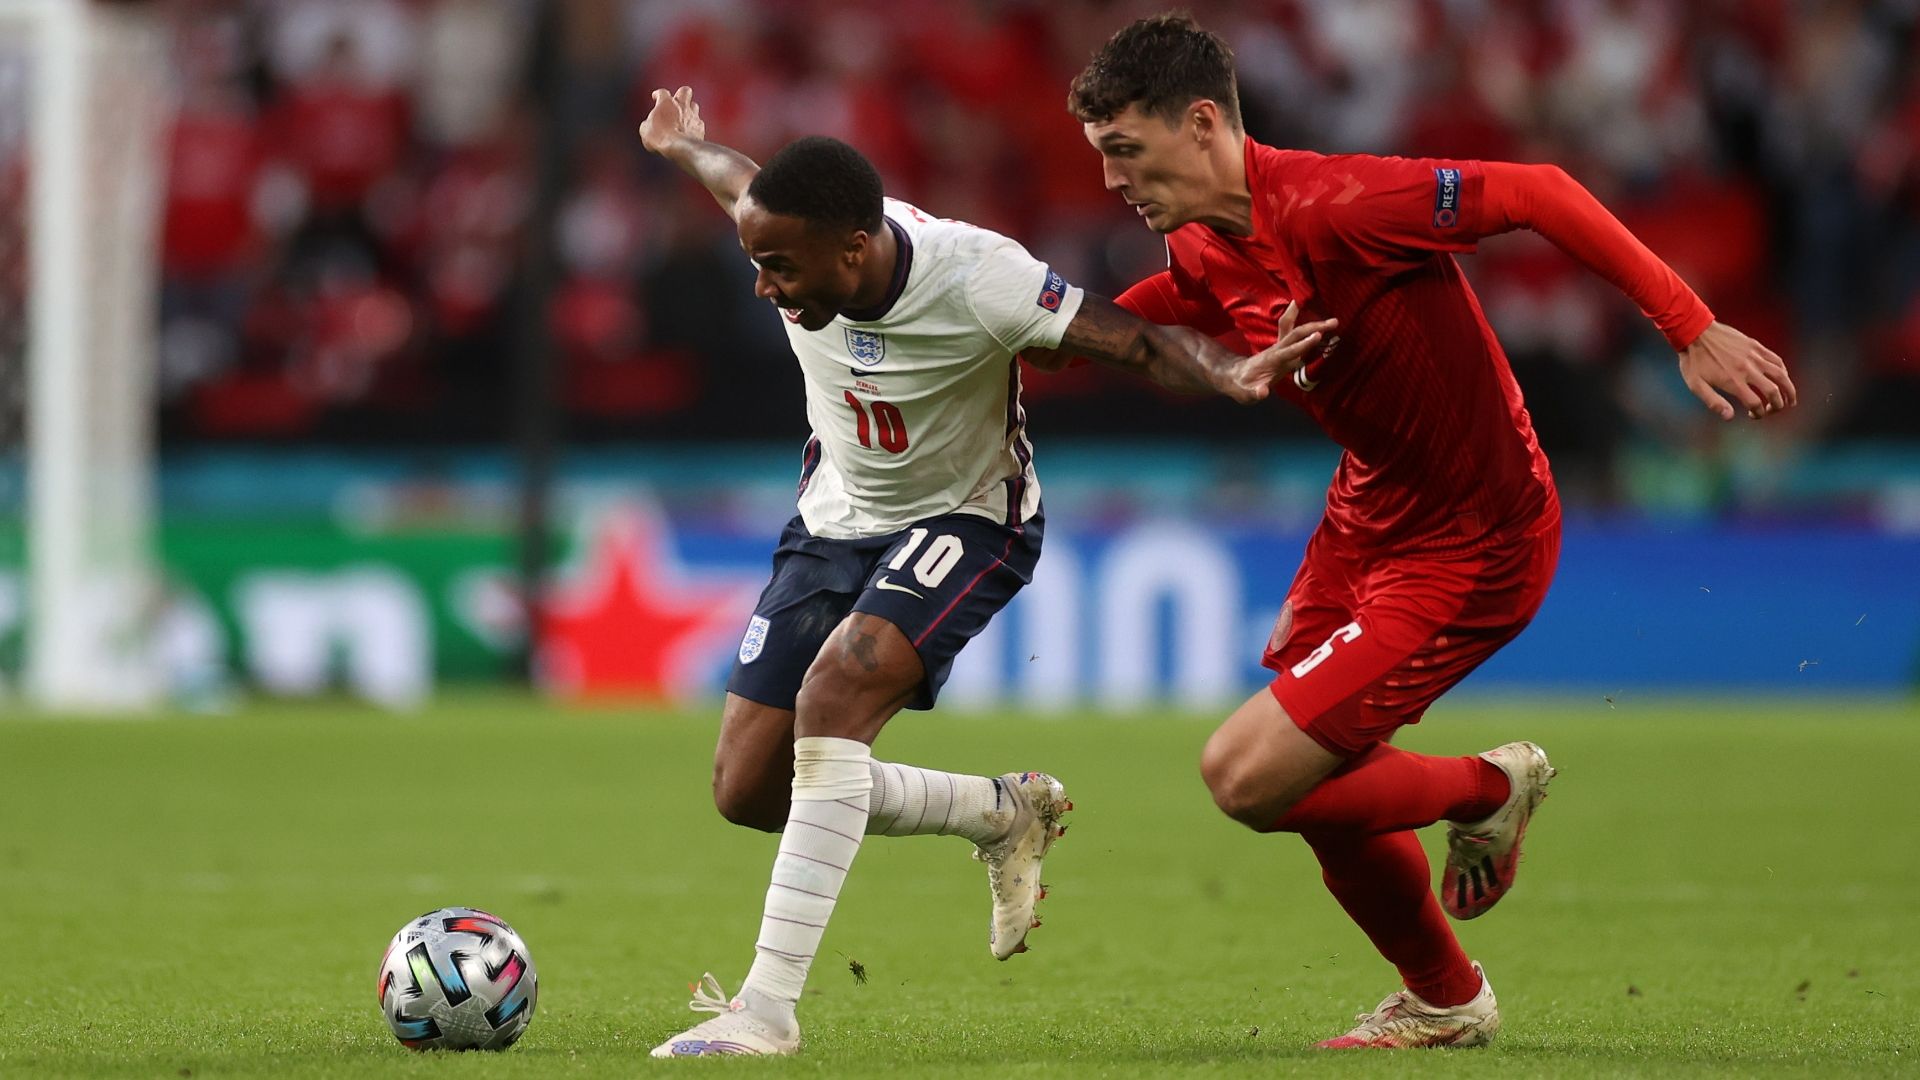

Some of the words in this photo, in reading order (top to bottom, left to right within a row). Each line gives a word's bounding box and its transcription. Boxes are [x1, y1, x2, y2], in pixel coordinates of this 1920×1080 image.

[844, 390, 909, 454] 10
[888, 528, 964, 588] 10
[1290, 621, 1362, 678] 6
